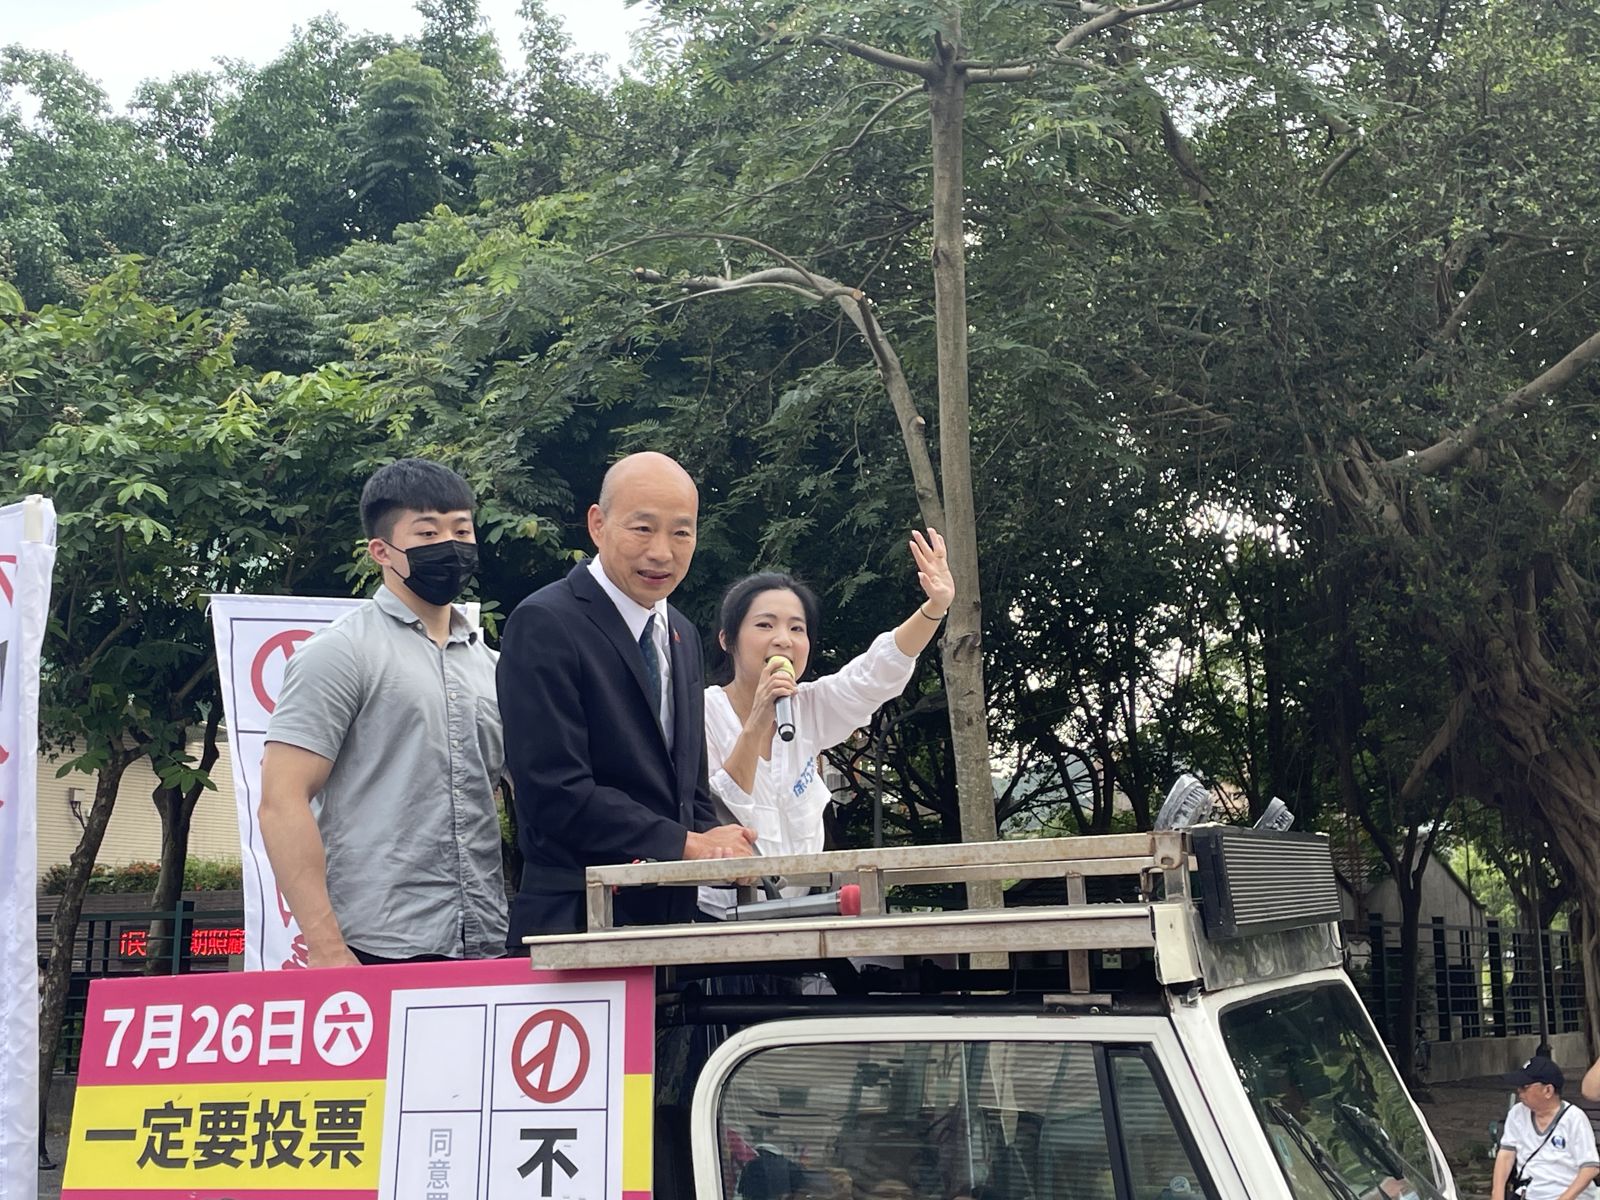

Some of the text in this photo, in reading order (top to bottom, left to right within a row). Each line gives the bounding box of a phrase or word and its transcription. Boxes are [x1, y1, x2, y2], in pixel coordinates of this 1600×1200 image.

[85, 1098, 367, 1170] 一定要投票
[517, 1128, 579, 1197] 不
